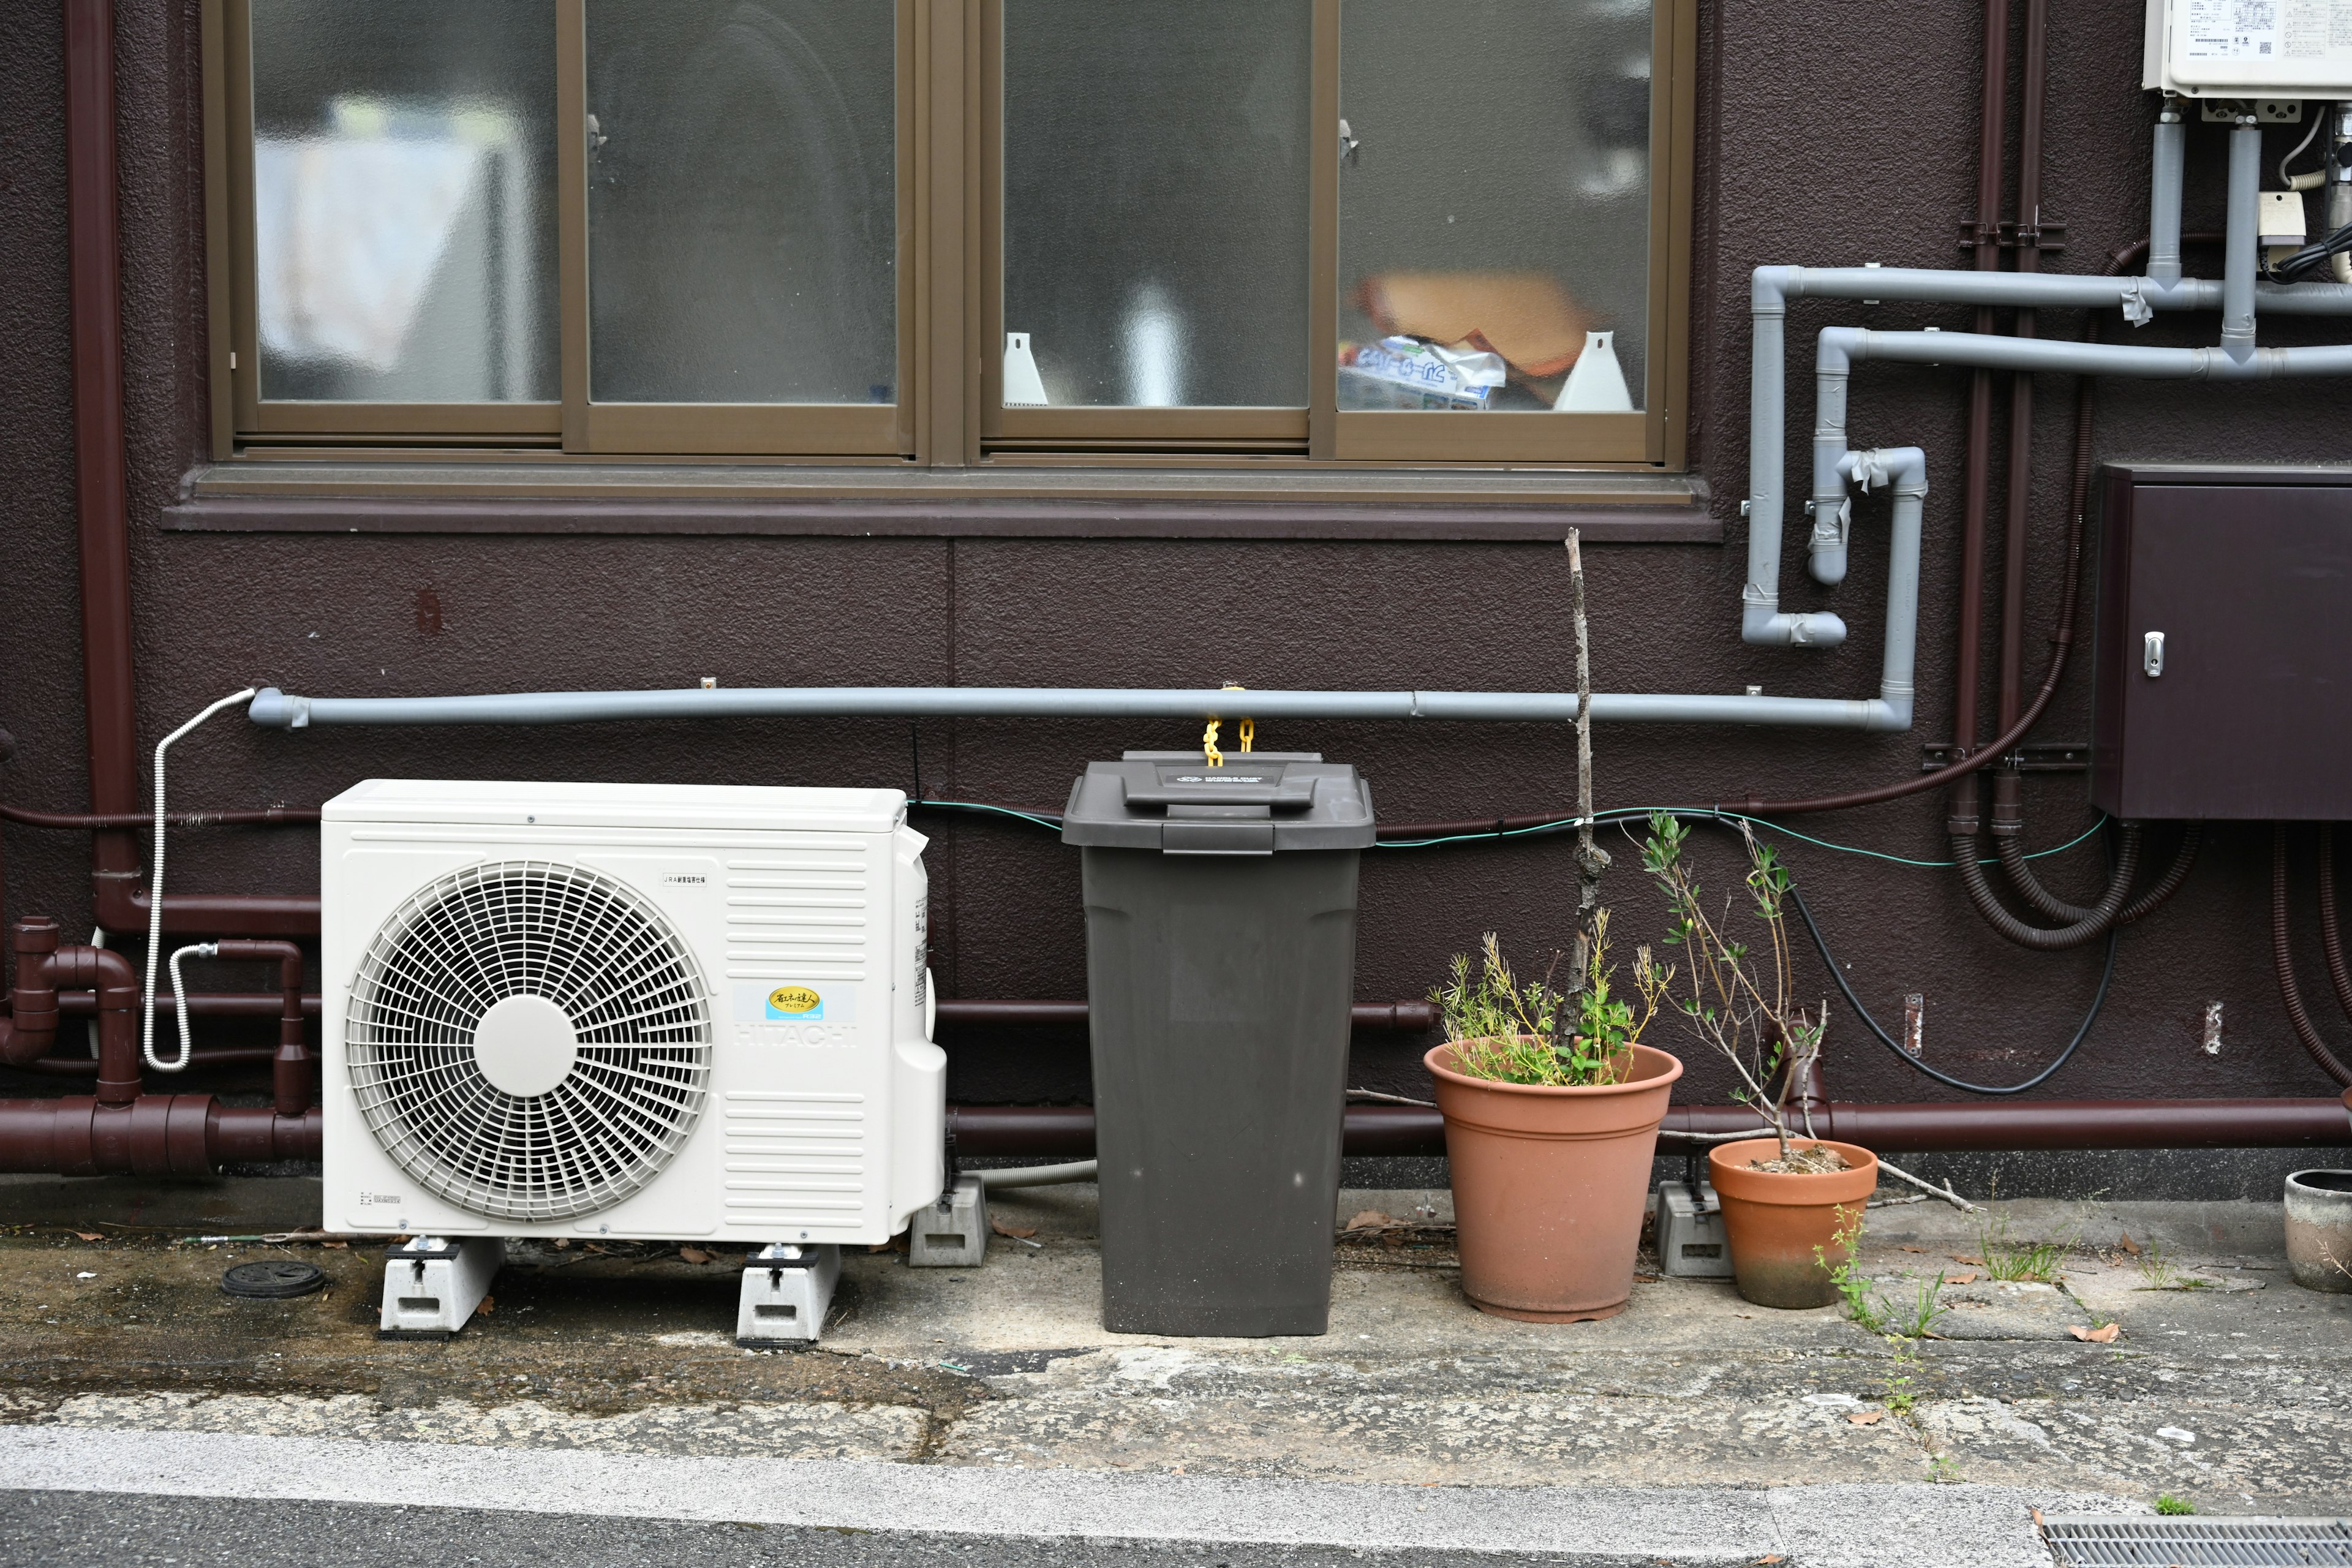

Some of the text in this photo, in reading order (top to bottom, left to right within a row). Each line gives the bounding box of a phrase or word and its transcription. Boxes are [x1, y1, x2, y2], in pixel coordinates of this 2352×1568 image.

[774, 992, 815, 1003] 省エネの達人
[733, 1024, 857, 1048] HITACHI
